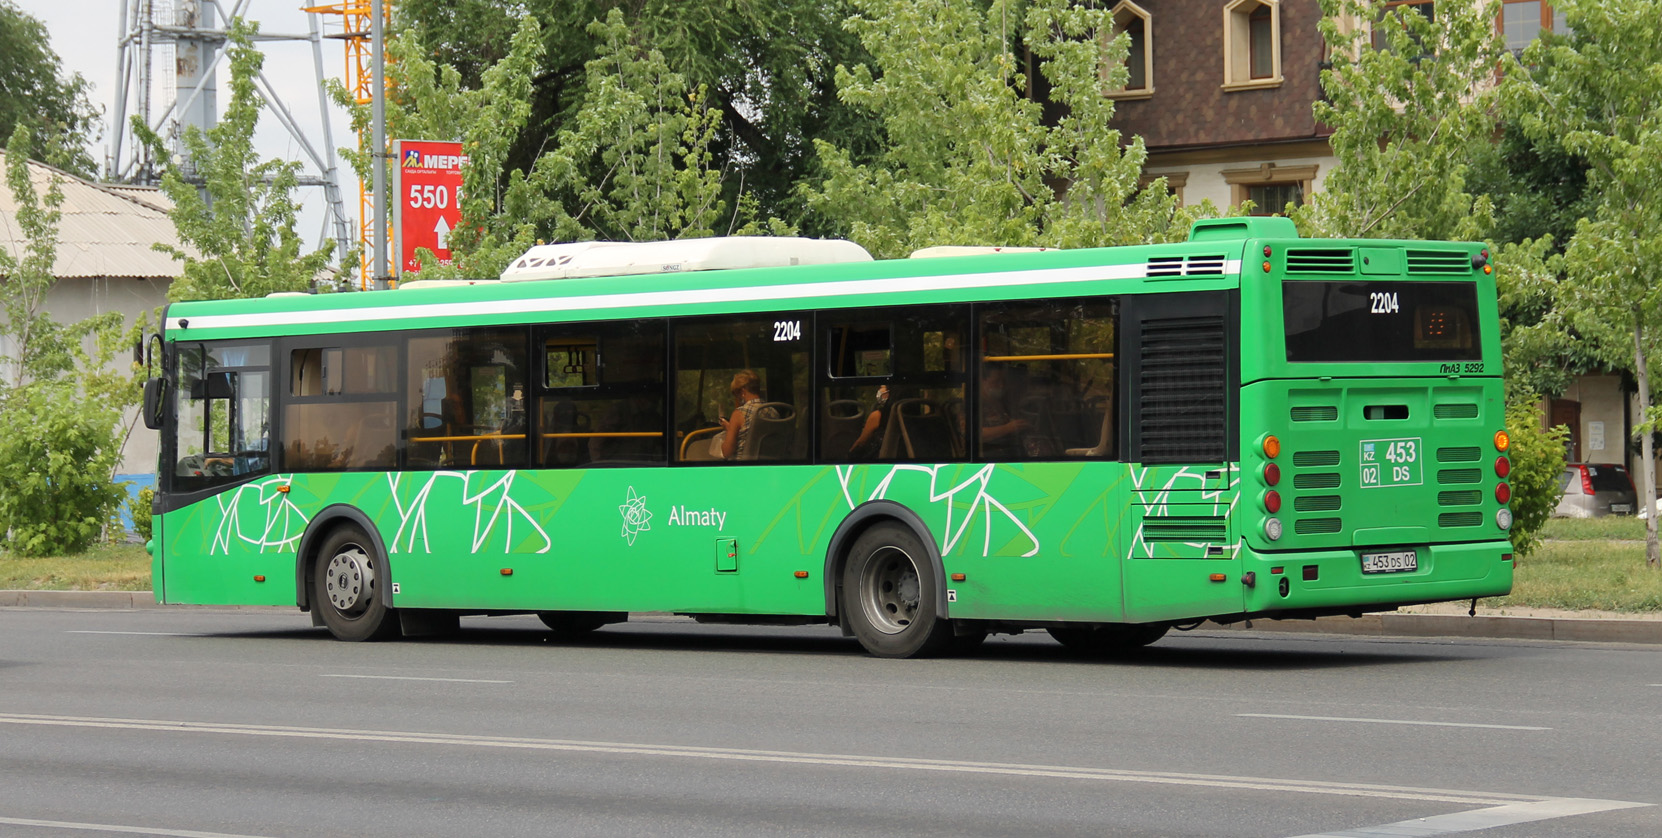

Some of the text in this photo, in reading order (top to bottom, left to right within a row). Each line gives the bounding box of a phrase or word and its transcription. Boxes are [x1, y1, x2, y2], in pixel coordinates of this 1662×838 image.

[409, 184, 448, 209] 550
[1370, 292, 1399, 314] 2204
[773, 320, 801, 342] 2204
[1464, 363, 1484, 373] 5292
[1363, 451, 1375, 461] KZ
[1385, 441, 1416, 463] 453
[1363, 467, 1377, 484] 02
[1392, 466, 1410, 482] DS
[668, 505, 727, 532] Almaty
[1372, 554, 1416, 569] 453 DS 02
